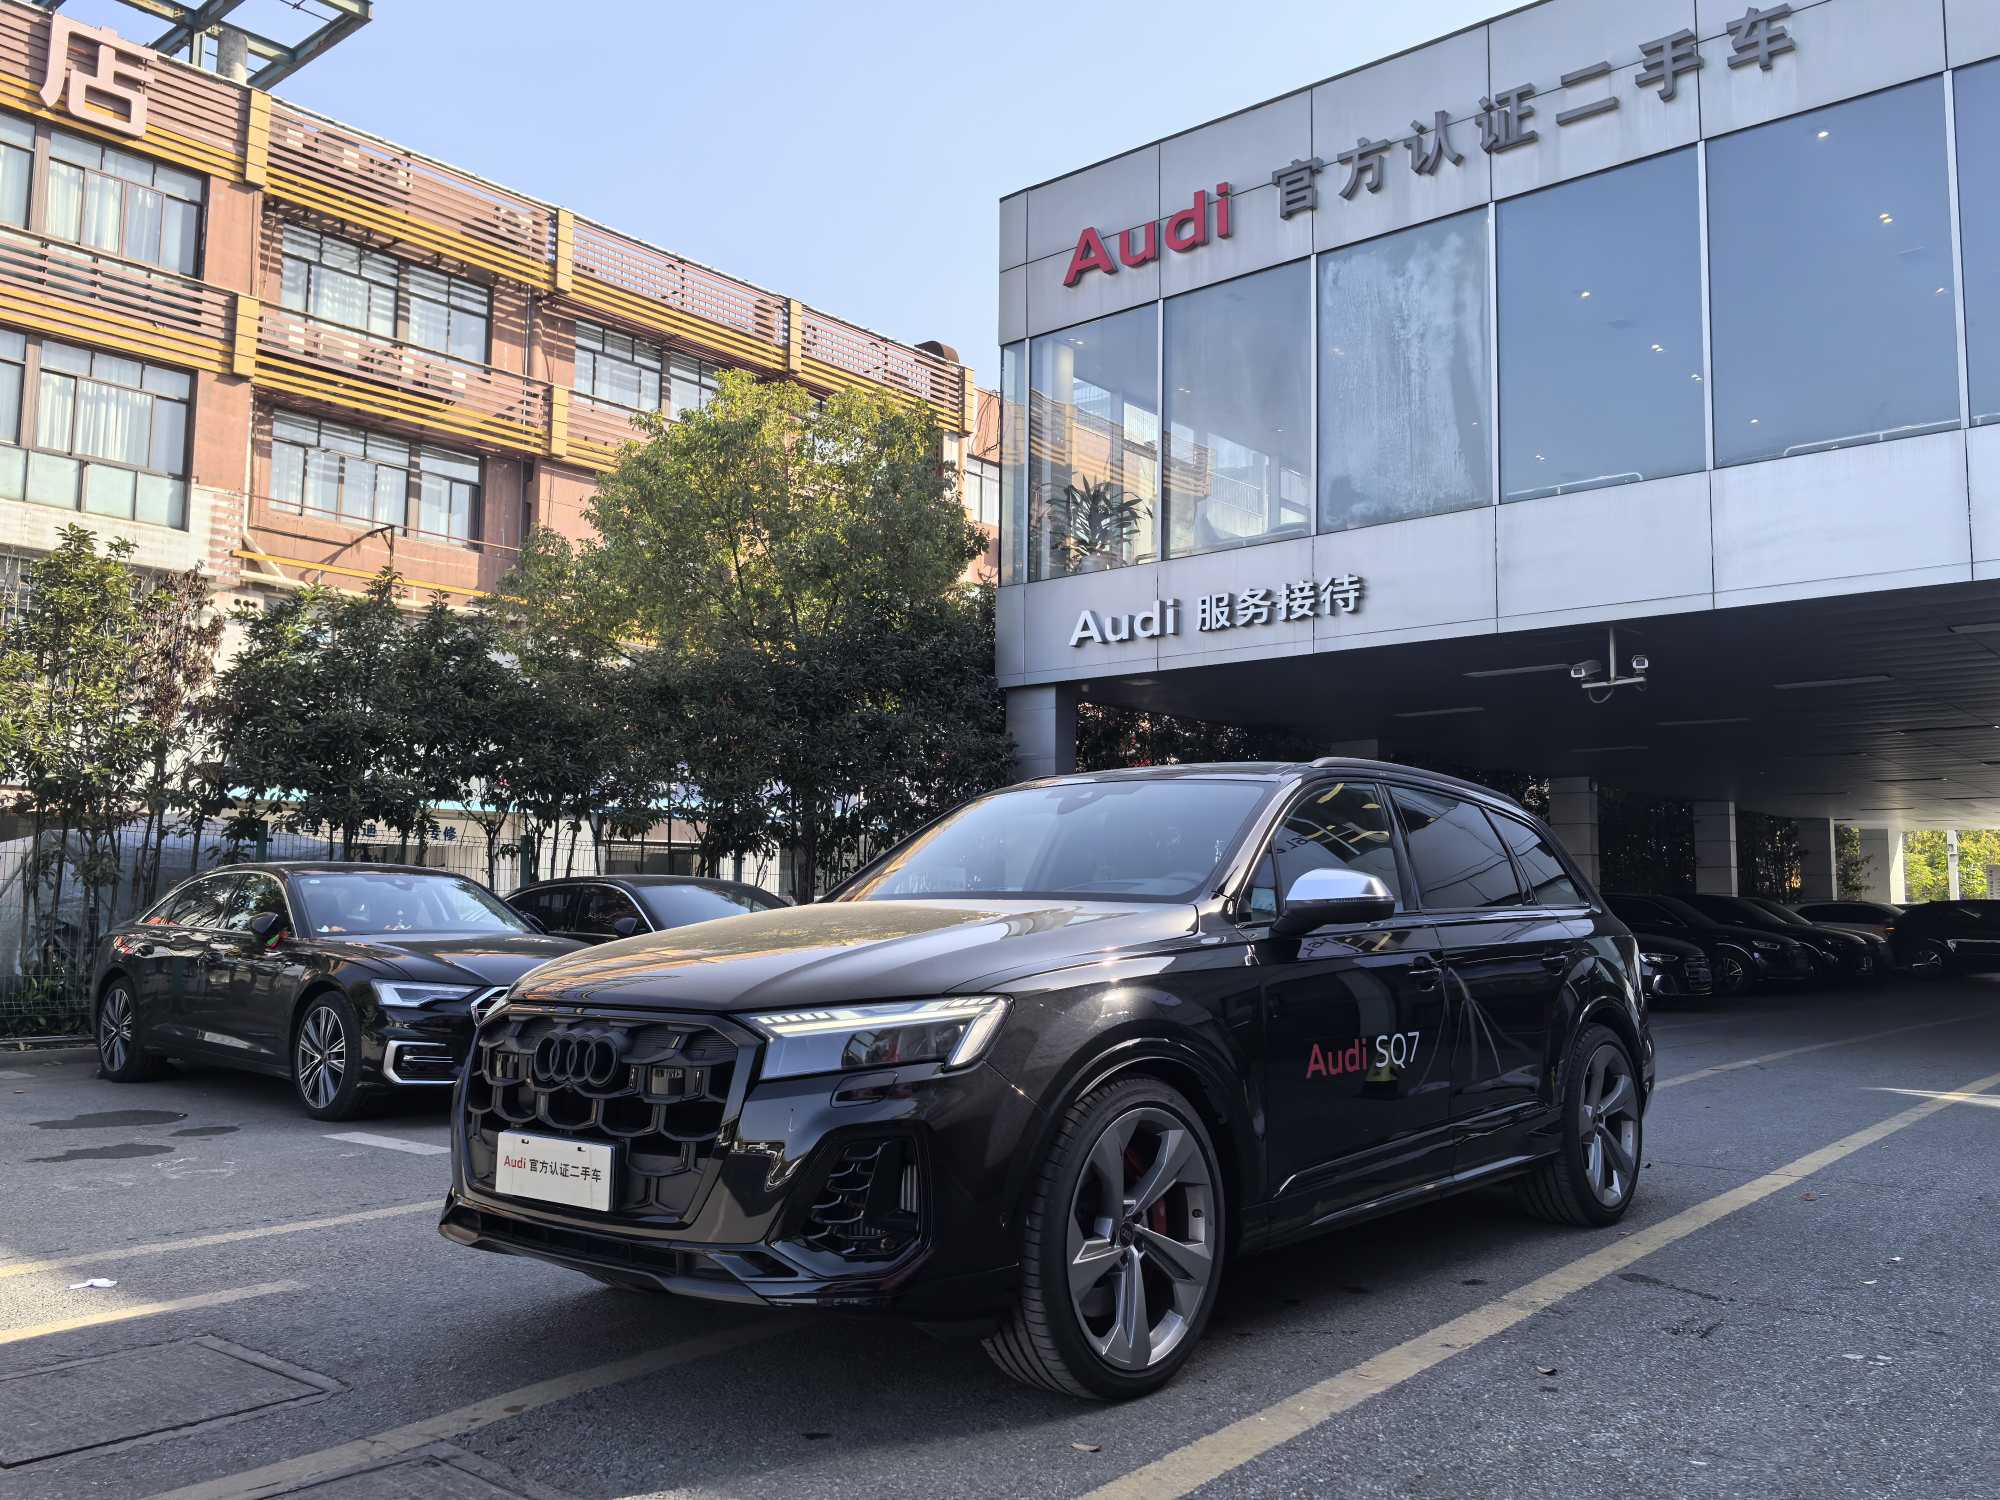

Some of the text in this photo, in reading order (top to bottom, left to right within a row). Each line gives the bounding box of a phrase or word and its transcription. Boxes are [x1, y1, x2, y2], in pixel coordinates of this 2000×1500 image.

[39, 14, 158, 138] 店
[1063, 3, 1797, 288] Audi 官方认证二手车
[1068, 573, 1363, 648] Audi 服务接待
[1305, 1031, 1420, 1079] Audi SQ7
[503, 1155, 602, 1182] Audi 官方认证二手车
